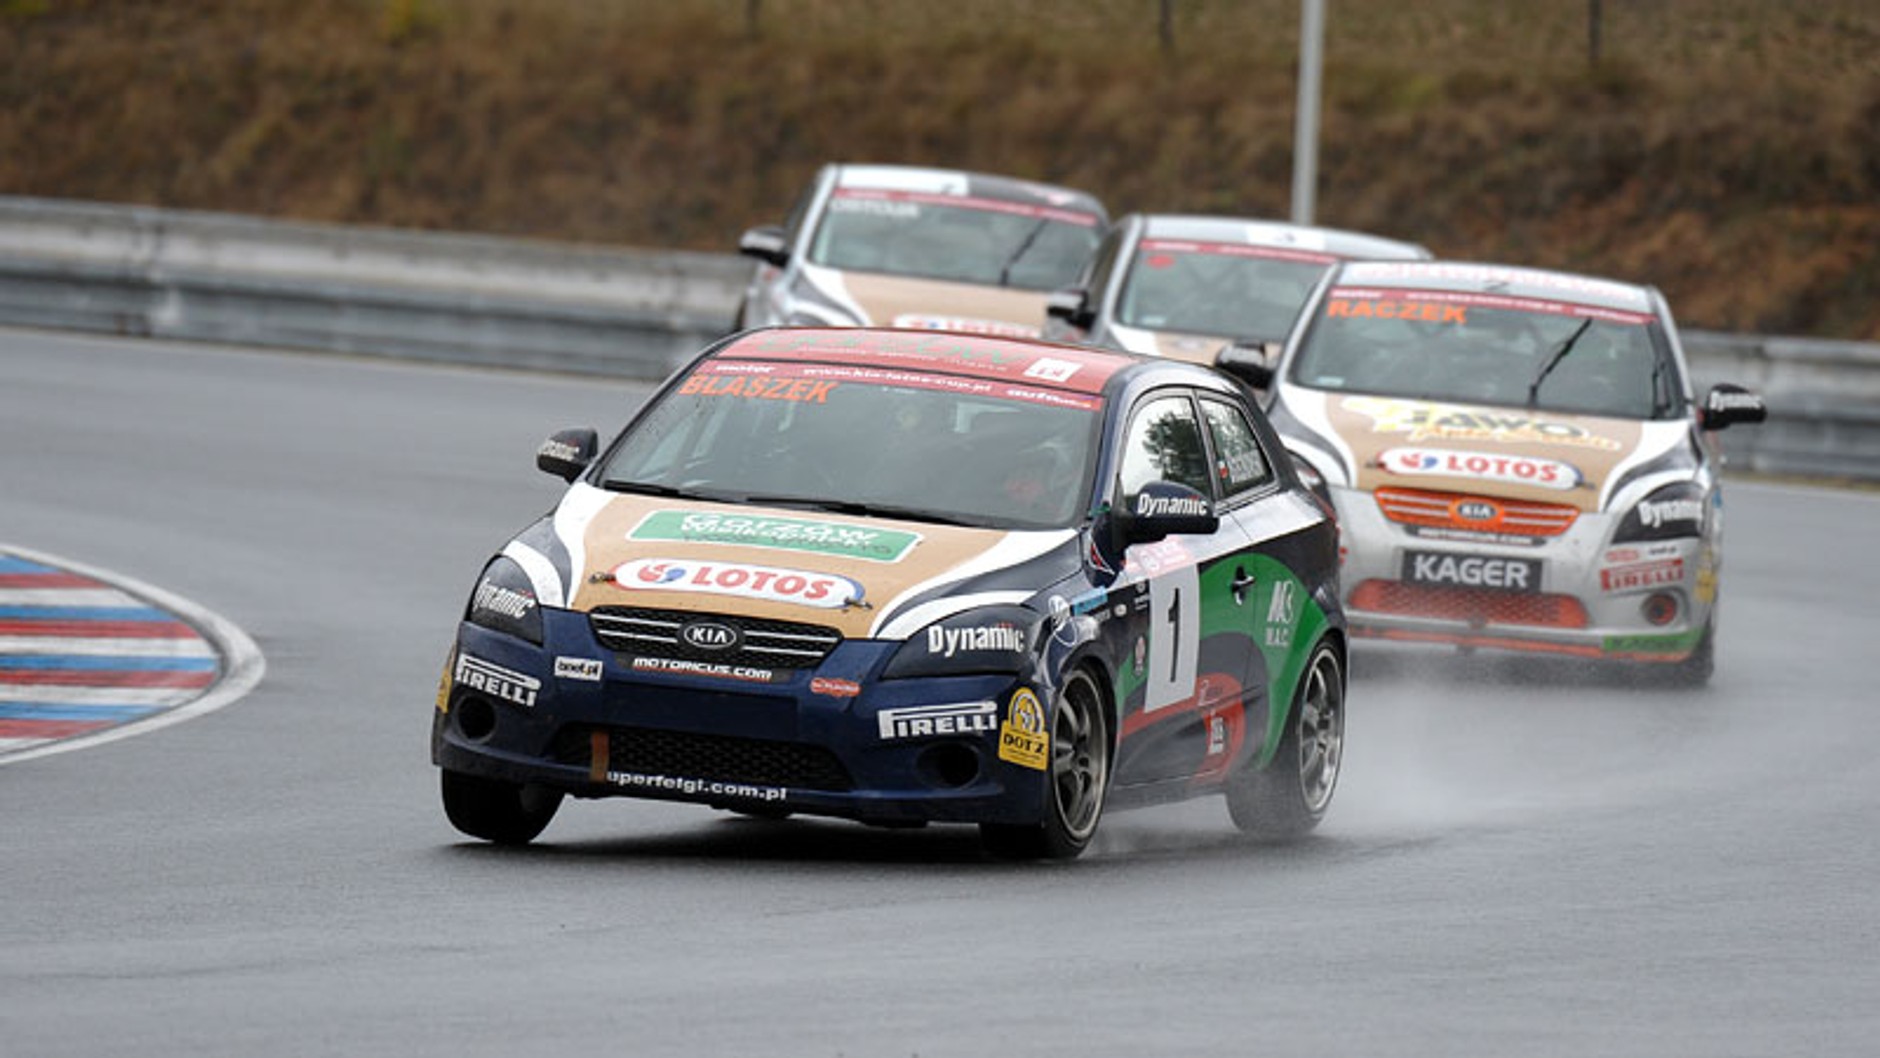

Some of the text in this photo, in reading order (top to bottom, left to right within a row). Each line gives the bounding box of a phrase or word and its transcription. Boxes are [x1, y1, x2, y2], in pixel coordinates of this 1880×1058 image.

[1327, 299, 1467, 323] RACZEK
[678, 374, 838, 404] BLASZEK
[1447, 455, 1558, 482] LOTOS
[1136, 493, 1208, 517] Dynamic
[1461, 503, 1492, 519] KIA
[691, 565, 836, 601] LOTOS
[1414, 555, 1530, 588] KAGER
[1600, 557, 1685, 591] PIRELLI
[692, 626, 728, 645] KIA
[927, 624, 1025, 658] Dynamic
[1167, 587, 1181, 683] 1
[455, 653, 541, 707] PIRELLI
[877, 700, 998, 740] PIRELLI
[1003, 734, 1045, 755] DOTZ
[606, 770, 787, 801] uperfelgi.com.pl
